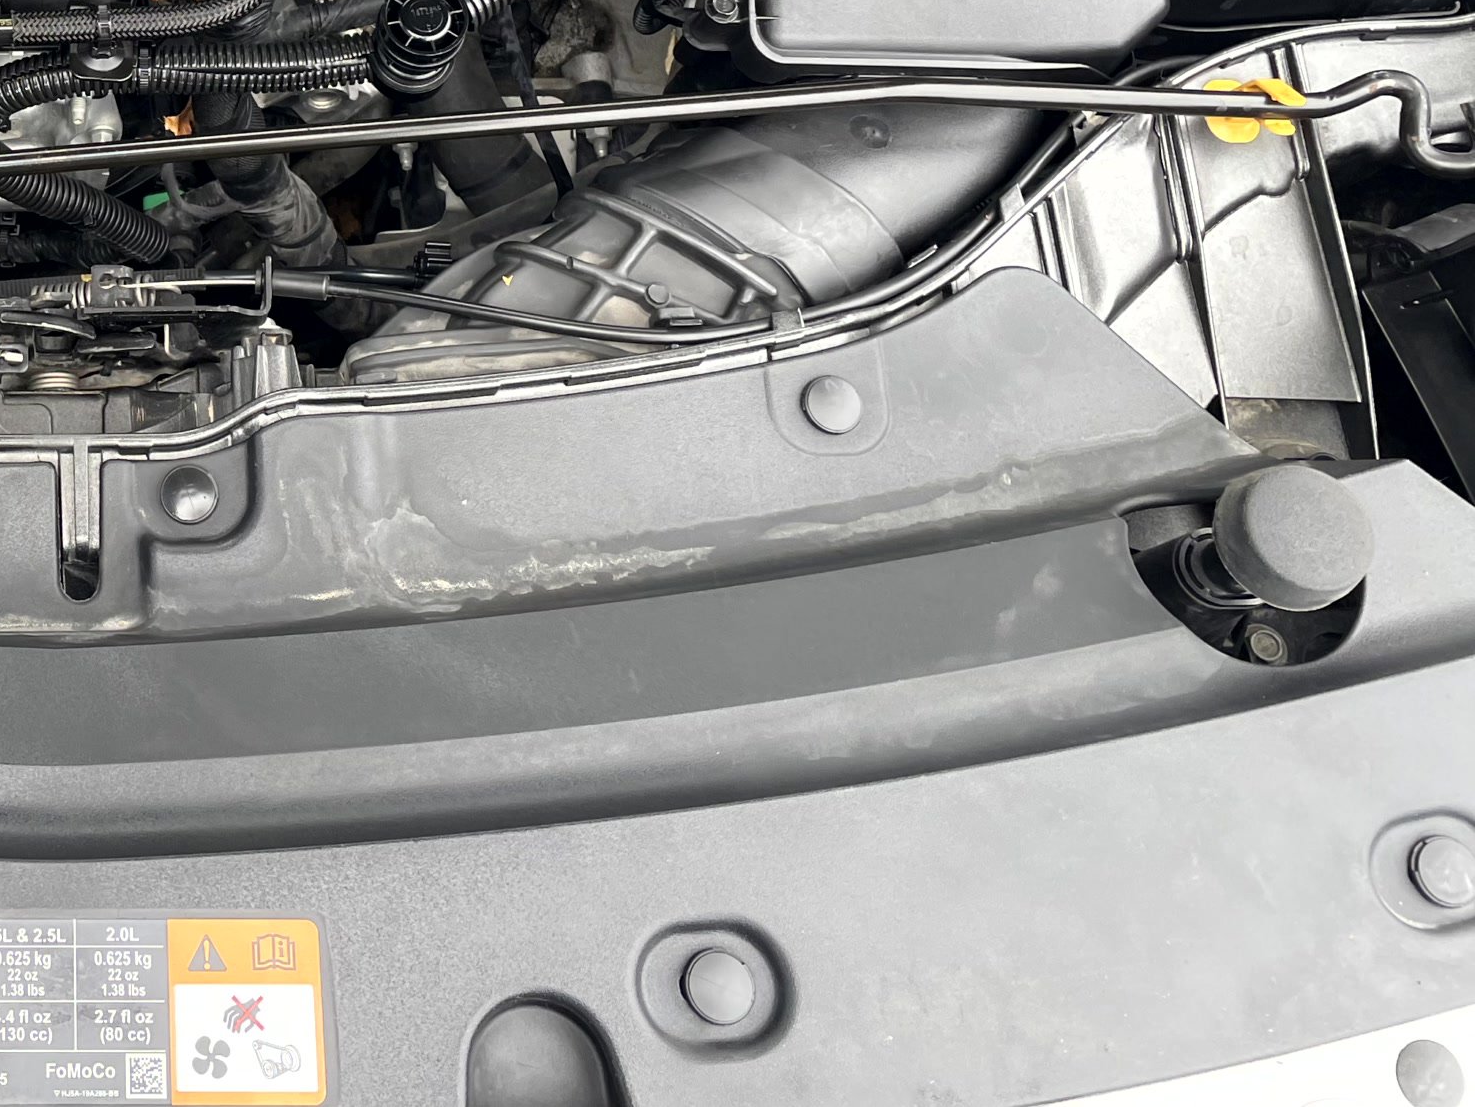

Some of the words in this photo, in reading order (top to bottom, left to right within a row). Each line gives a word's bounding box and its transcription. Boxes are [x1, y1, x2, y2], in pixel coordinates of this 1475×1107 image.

[17, 929, 28, 942] &
[33, 928, 66, 943] 2.5L
[106, 927, 139, 942] 2.0L
[34, 951, 51, 969] kg
[94, 951, 131, 966] 0.625
[134, 951, 152, 969] kg
[7, 969, 21, 981] 22
[24, 971, 38, 981] oz
[108, 969, 122, 981] 22
[125, 971, 139, 981] oz
[1, 984, 23, 996] 1.38
[27, 984, 45, 996] lbs
[101, 984, 124, 996] 1.38
[128, 984, 146, 996] lbs
[19, 1009, 29, 1024] fl
[33, 1012, 52, 1024] oz
[94, 1010, 116, 1024] 2.7
[121, 1009, 131, 1024] fl
[135, 1012, 153, 1024] oz
[29, 1027, 53, 1044] cc)
[100, 1027, 123, 1044] (80
[127, 1027, 151, 1044] cc)
[45, 1062, 116, 1079] FoMoCo
